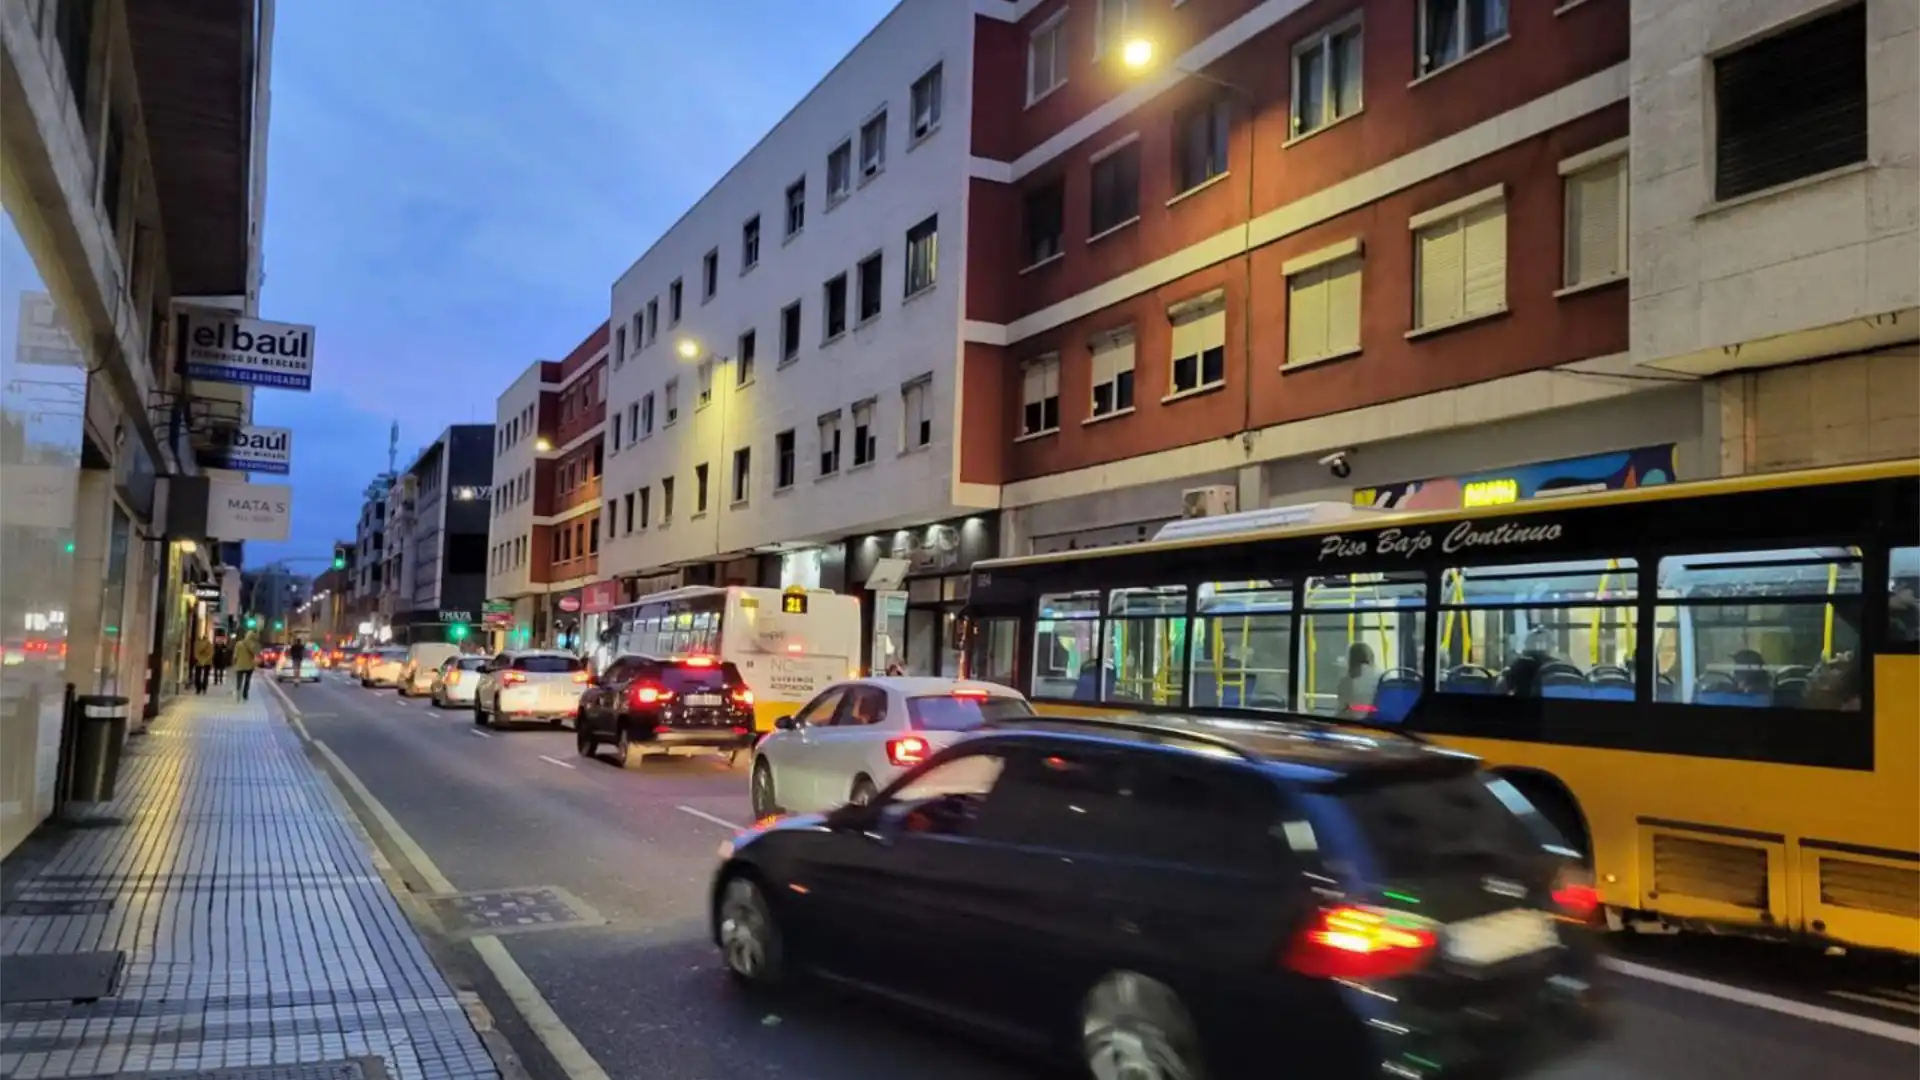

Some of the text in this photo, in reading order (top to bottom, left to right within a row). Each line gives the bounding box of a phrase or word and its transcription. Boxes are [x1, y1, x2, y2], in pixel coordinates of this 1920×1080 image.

[194, 323, 308, 358] el baúl
[233, 427, 287, 451] baúl
[1319, 520, 1562, 562] Piso Bajo Continuo
[787, 596, 801, 612] 21
